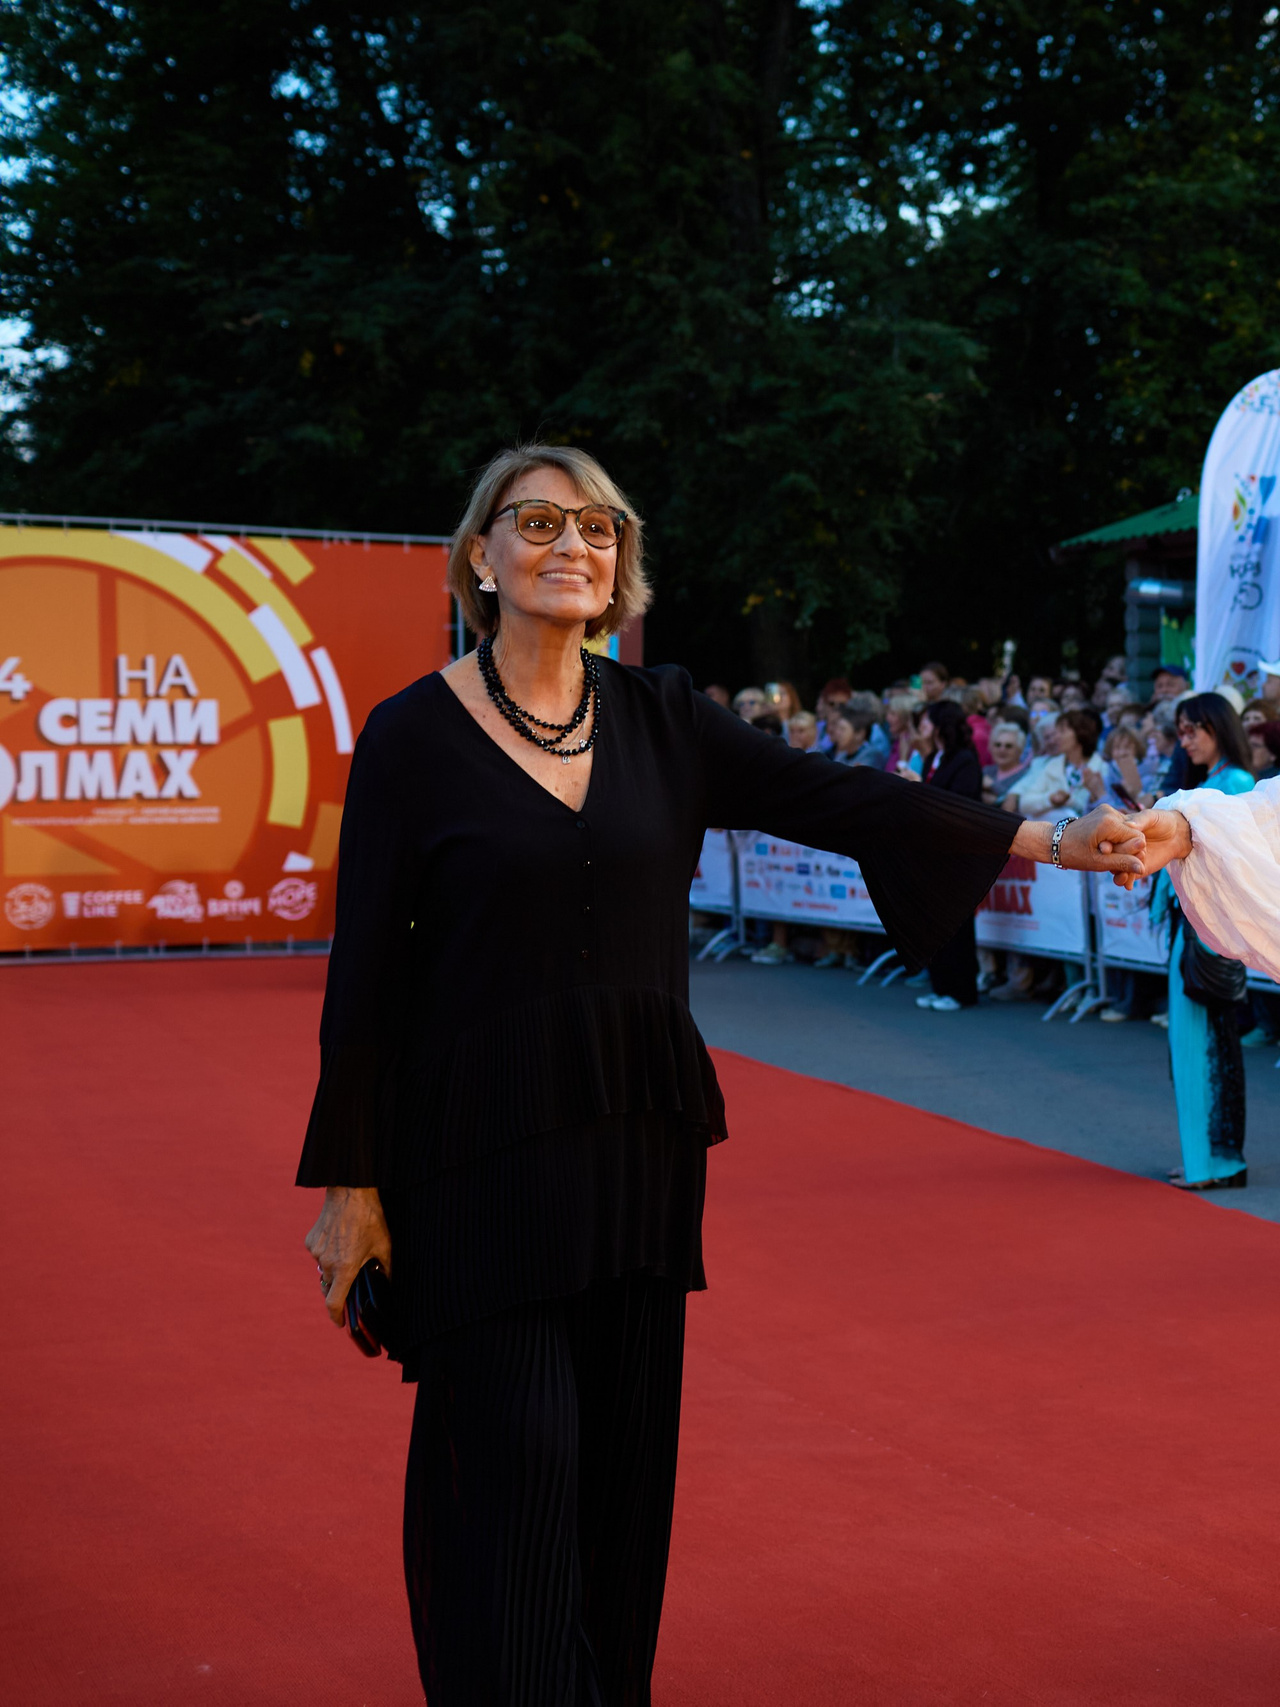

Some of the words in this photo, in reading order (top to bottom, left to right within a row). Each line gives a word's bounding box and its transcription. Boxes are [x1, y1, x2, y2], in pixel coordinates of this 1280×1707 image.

[116, 653, 199, 698] НА
[37, 697, 220, 746] СЕМИ
[0, 746, 201, 804] ЛМАХ
[82, 890, 144, 905] COFFEE
[83, 903, 118, 917] LIKE
